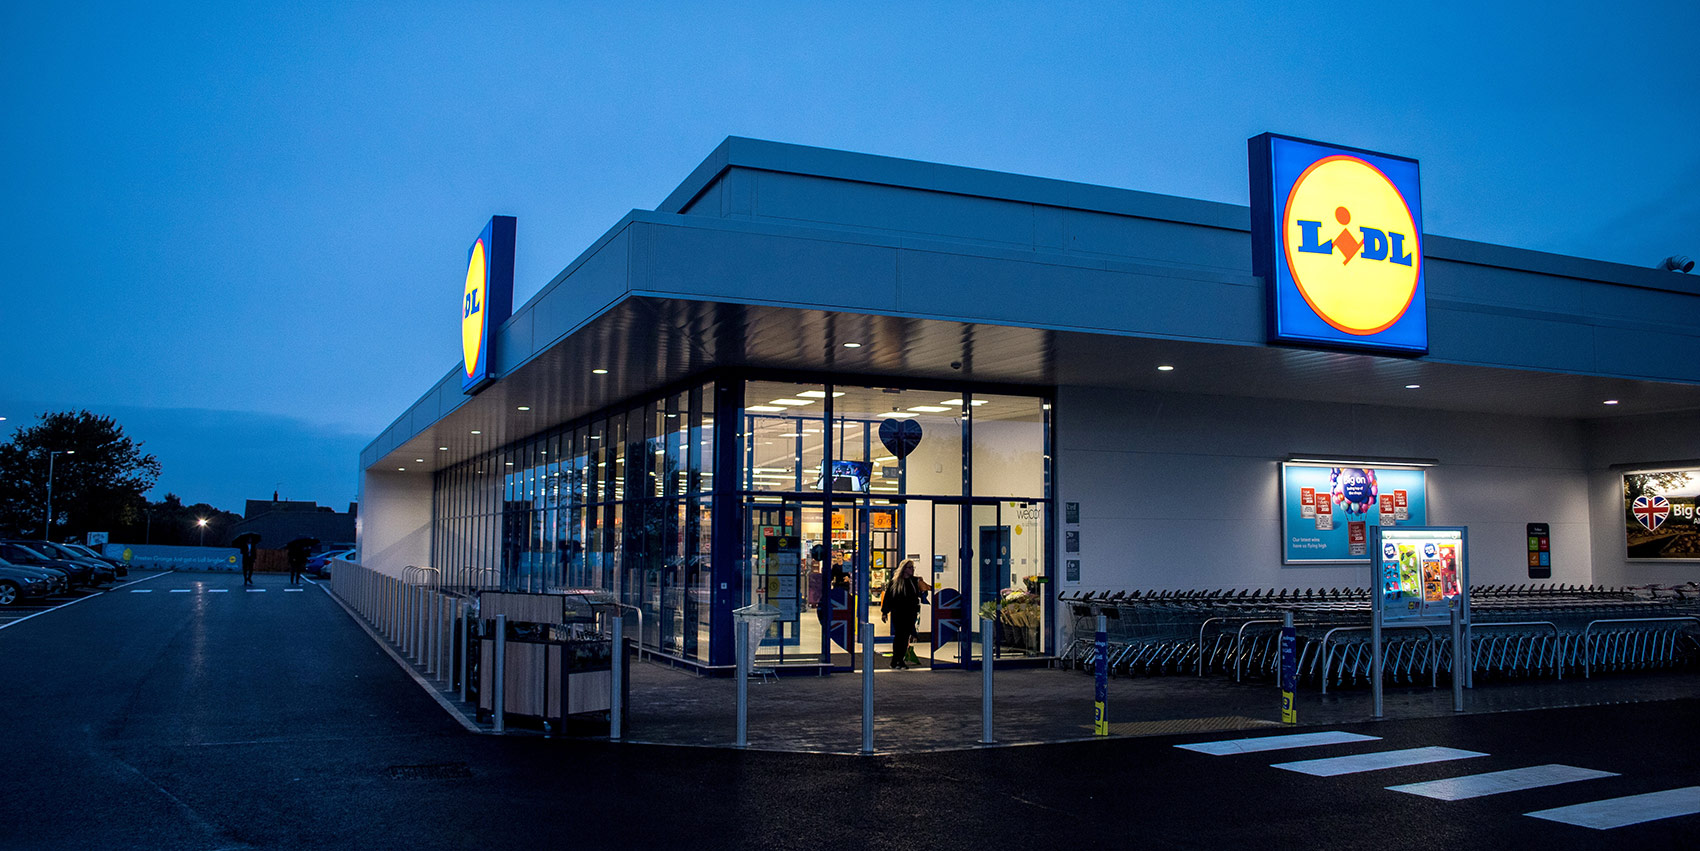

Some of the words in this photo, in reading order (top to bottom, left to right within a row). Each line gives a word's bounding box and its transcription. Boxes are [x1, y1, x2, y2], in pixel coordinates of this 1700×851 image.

[464, 288, 480, 319] DL
[1356, 476, 1366, 484] on
[1673, 503, 1693, 519] Big
